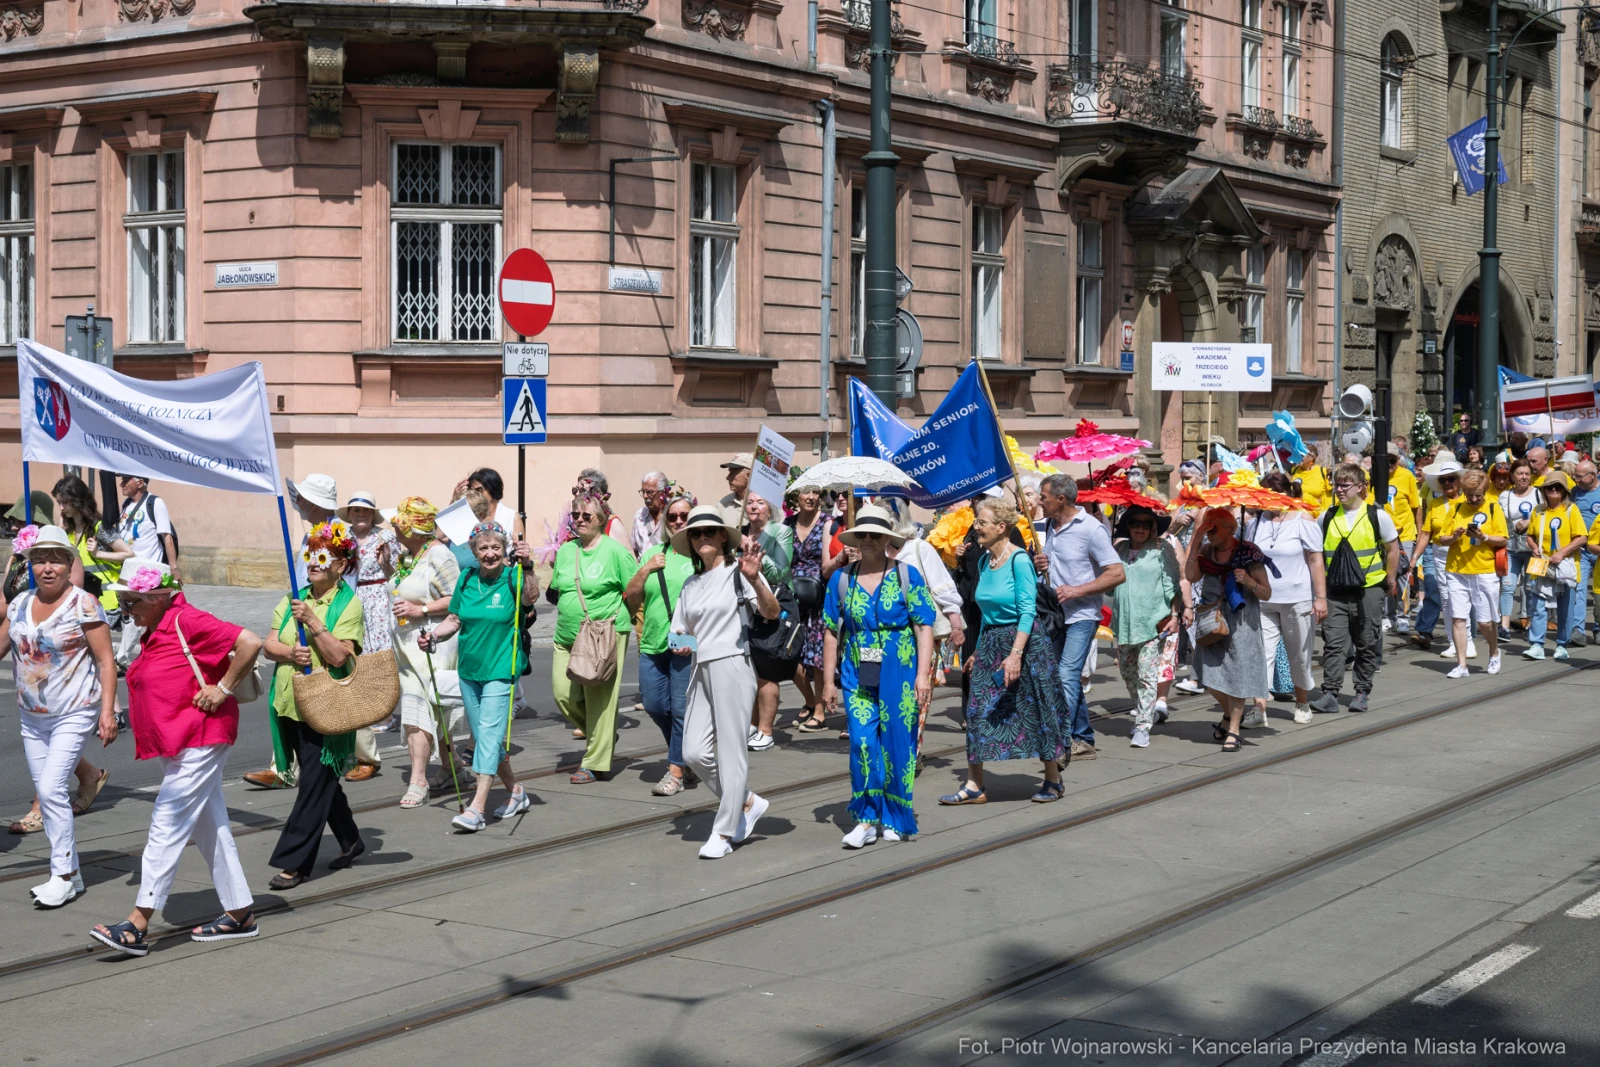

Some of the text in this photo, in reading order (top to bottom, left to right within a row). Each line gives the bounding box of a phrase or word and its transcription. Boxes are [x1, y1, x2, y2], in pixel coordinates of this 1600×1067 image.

[217, 272, 276, 284] JABŁONOWSKICH
[506, 345, 548, 357] Nie dotyczy
[147, 406, 216, 421] ROLNICZY
[932, 401, 980, 431] SENIORA
[225, 457, 266, 474] WIEKU
